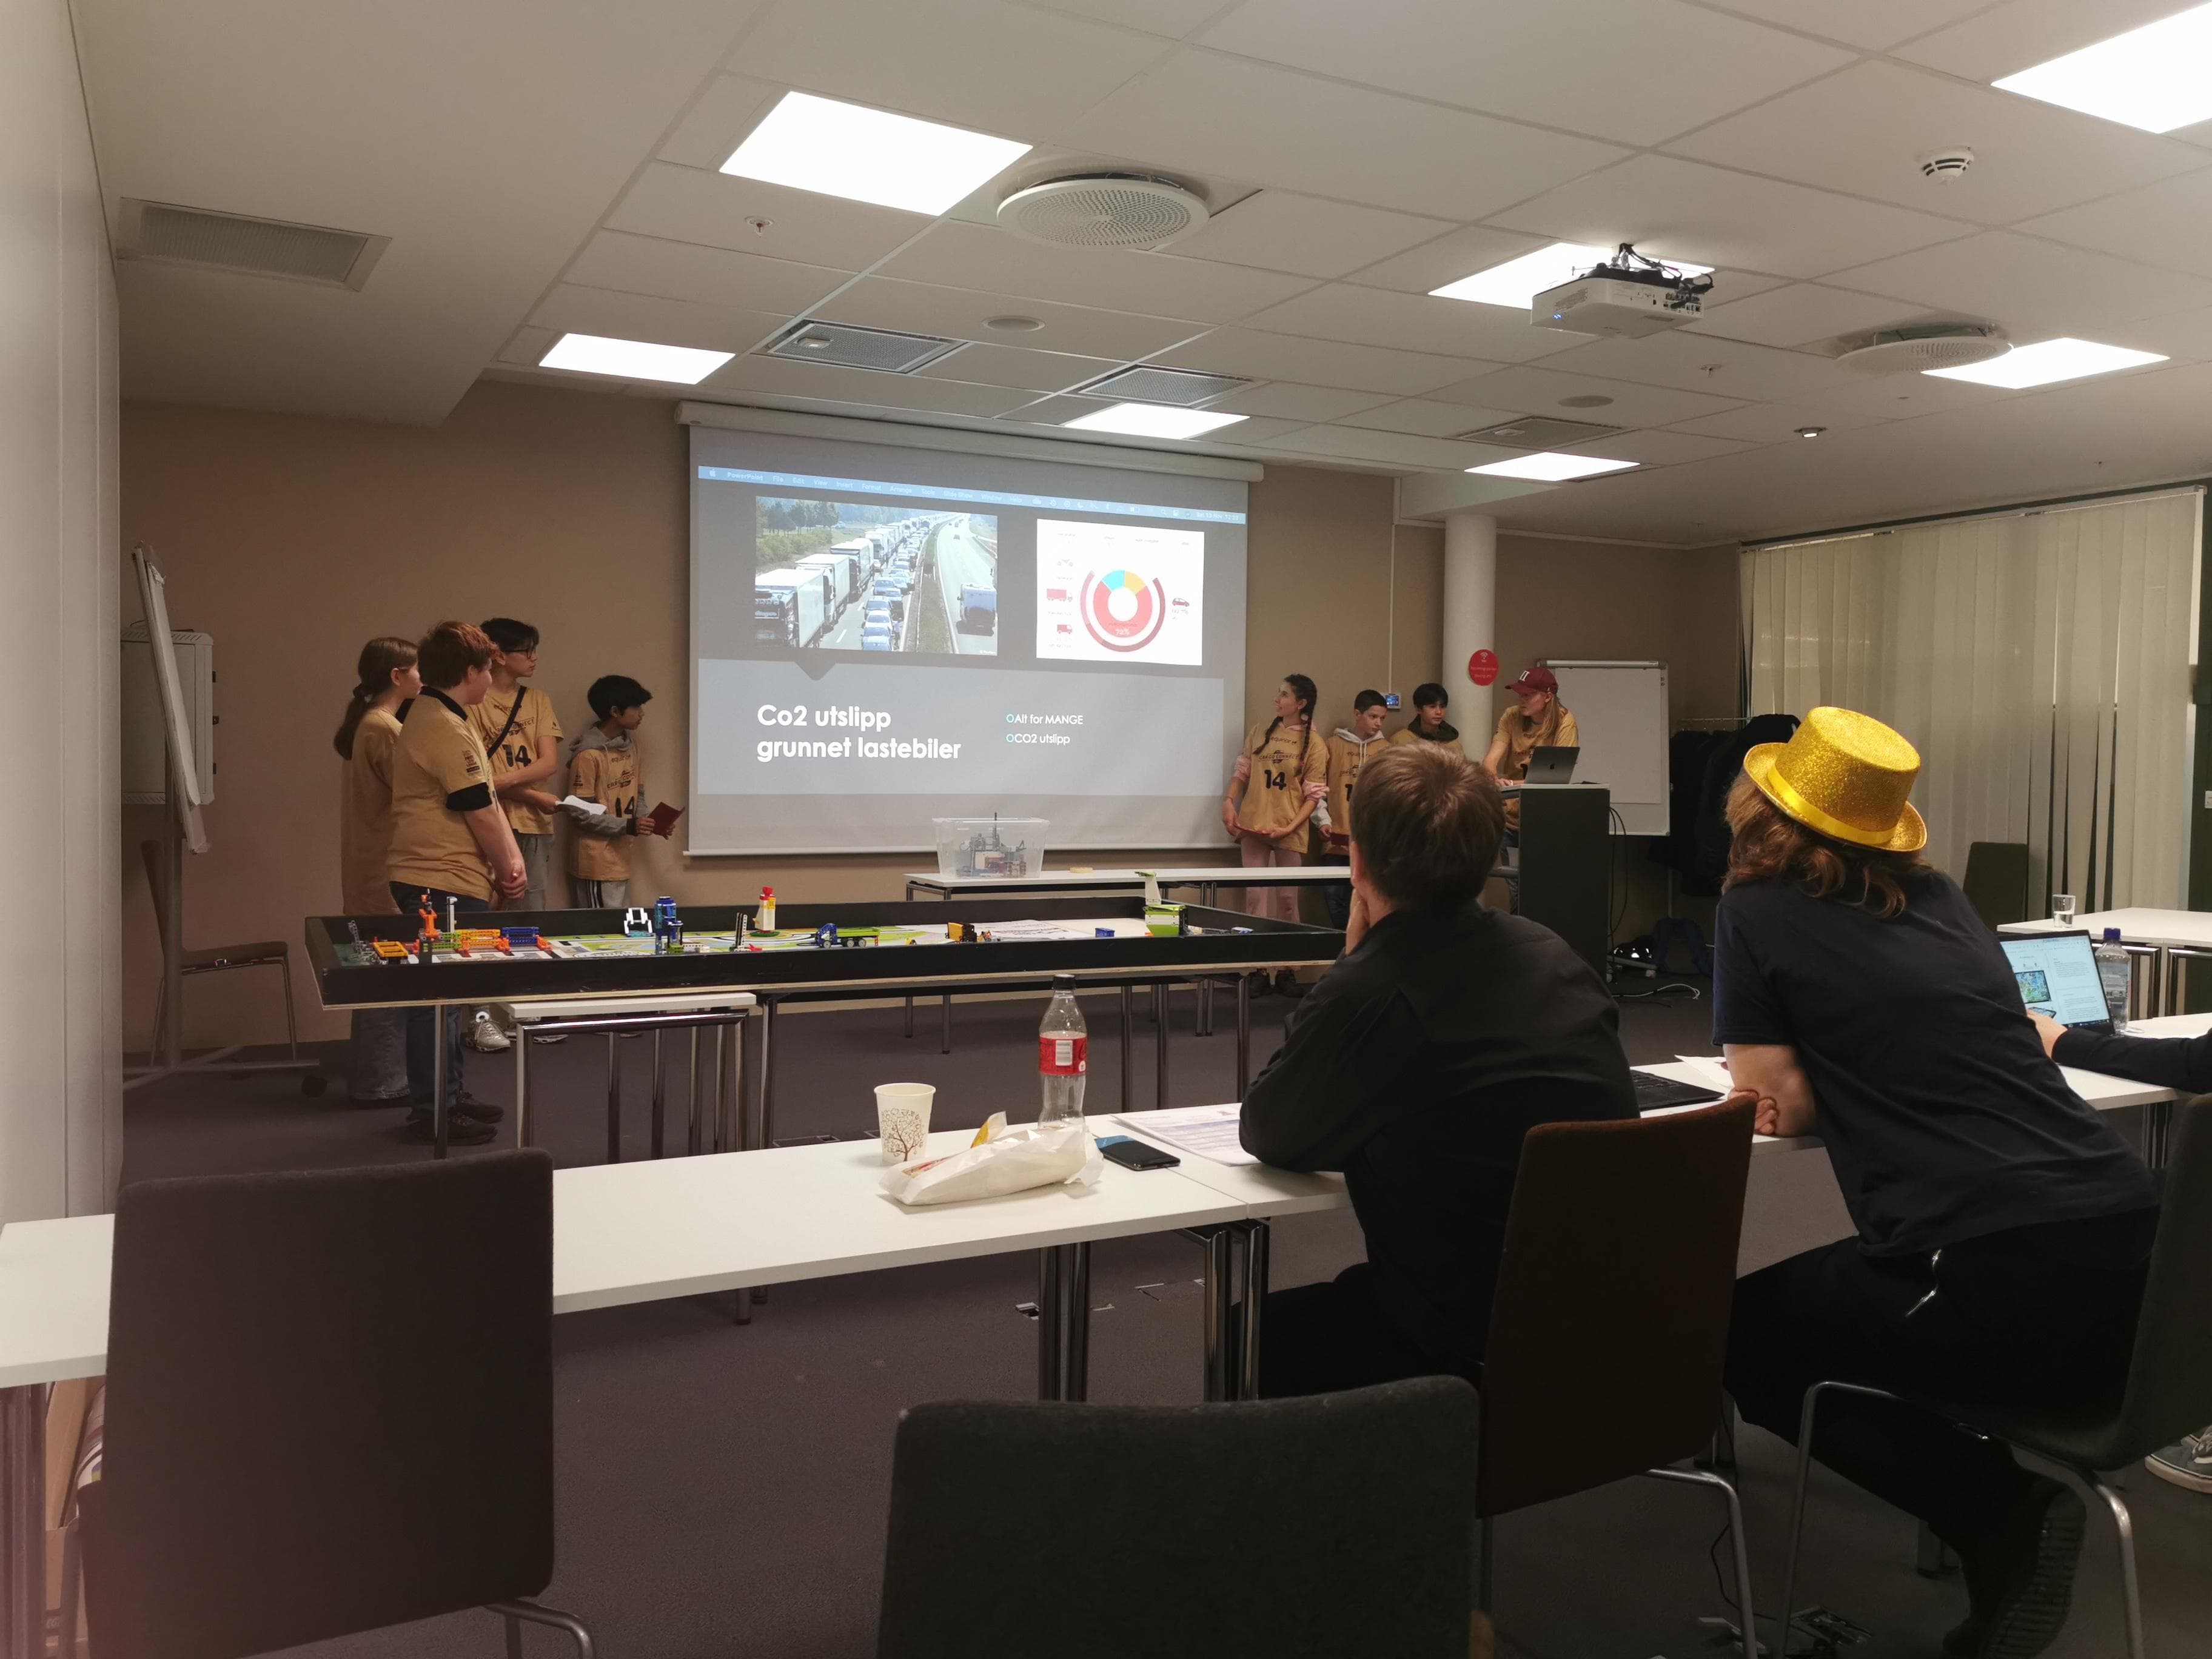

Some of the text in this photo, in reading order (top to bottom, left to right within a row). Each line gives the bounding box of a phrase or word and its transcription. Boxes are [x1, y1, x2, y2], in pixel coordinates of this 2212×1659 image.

[728, 472, 763, 481] PowerPoint
[757, 704, 891, 732] Co2 utslipp
[1014, 714, 1084, 725] Alt for MANGE
[757, 736, 962, 763] grunnet lastebiler
[1014, 733, 1071, 746] CO2 utslipp
[501, 743, 532, 767] 14
[1264, 769, 1287, 791] 14
[615, 796, 635, 819] 14
